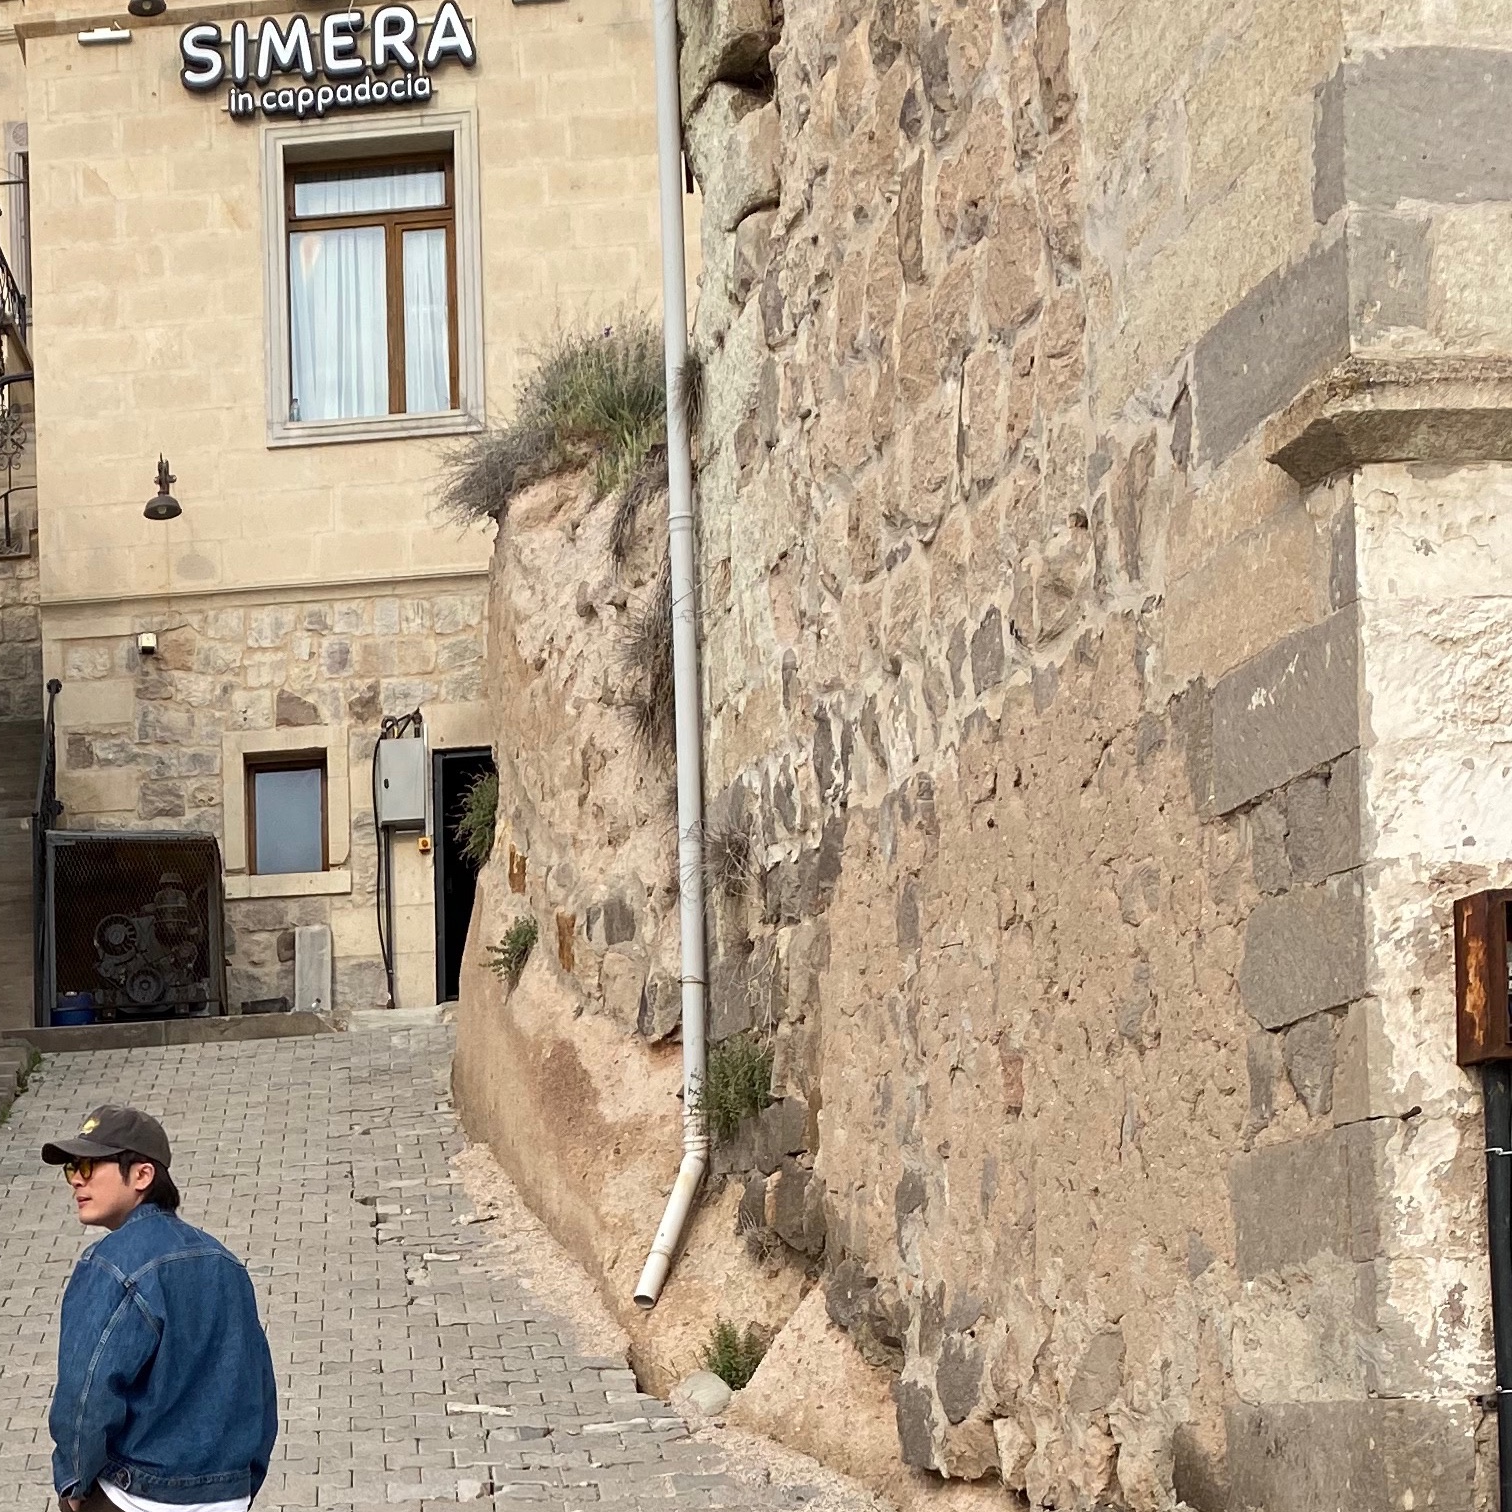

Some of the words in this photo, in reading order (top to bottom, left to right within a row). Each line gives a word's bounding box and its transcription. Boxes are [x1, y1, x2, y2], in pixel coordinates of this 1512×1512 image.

[181, 1, 475, 89] SIMERA
[229, 88, 254, 114] in
[262, 73, 431, 115] cappadocia
